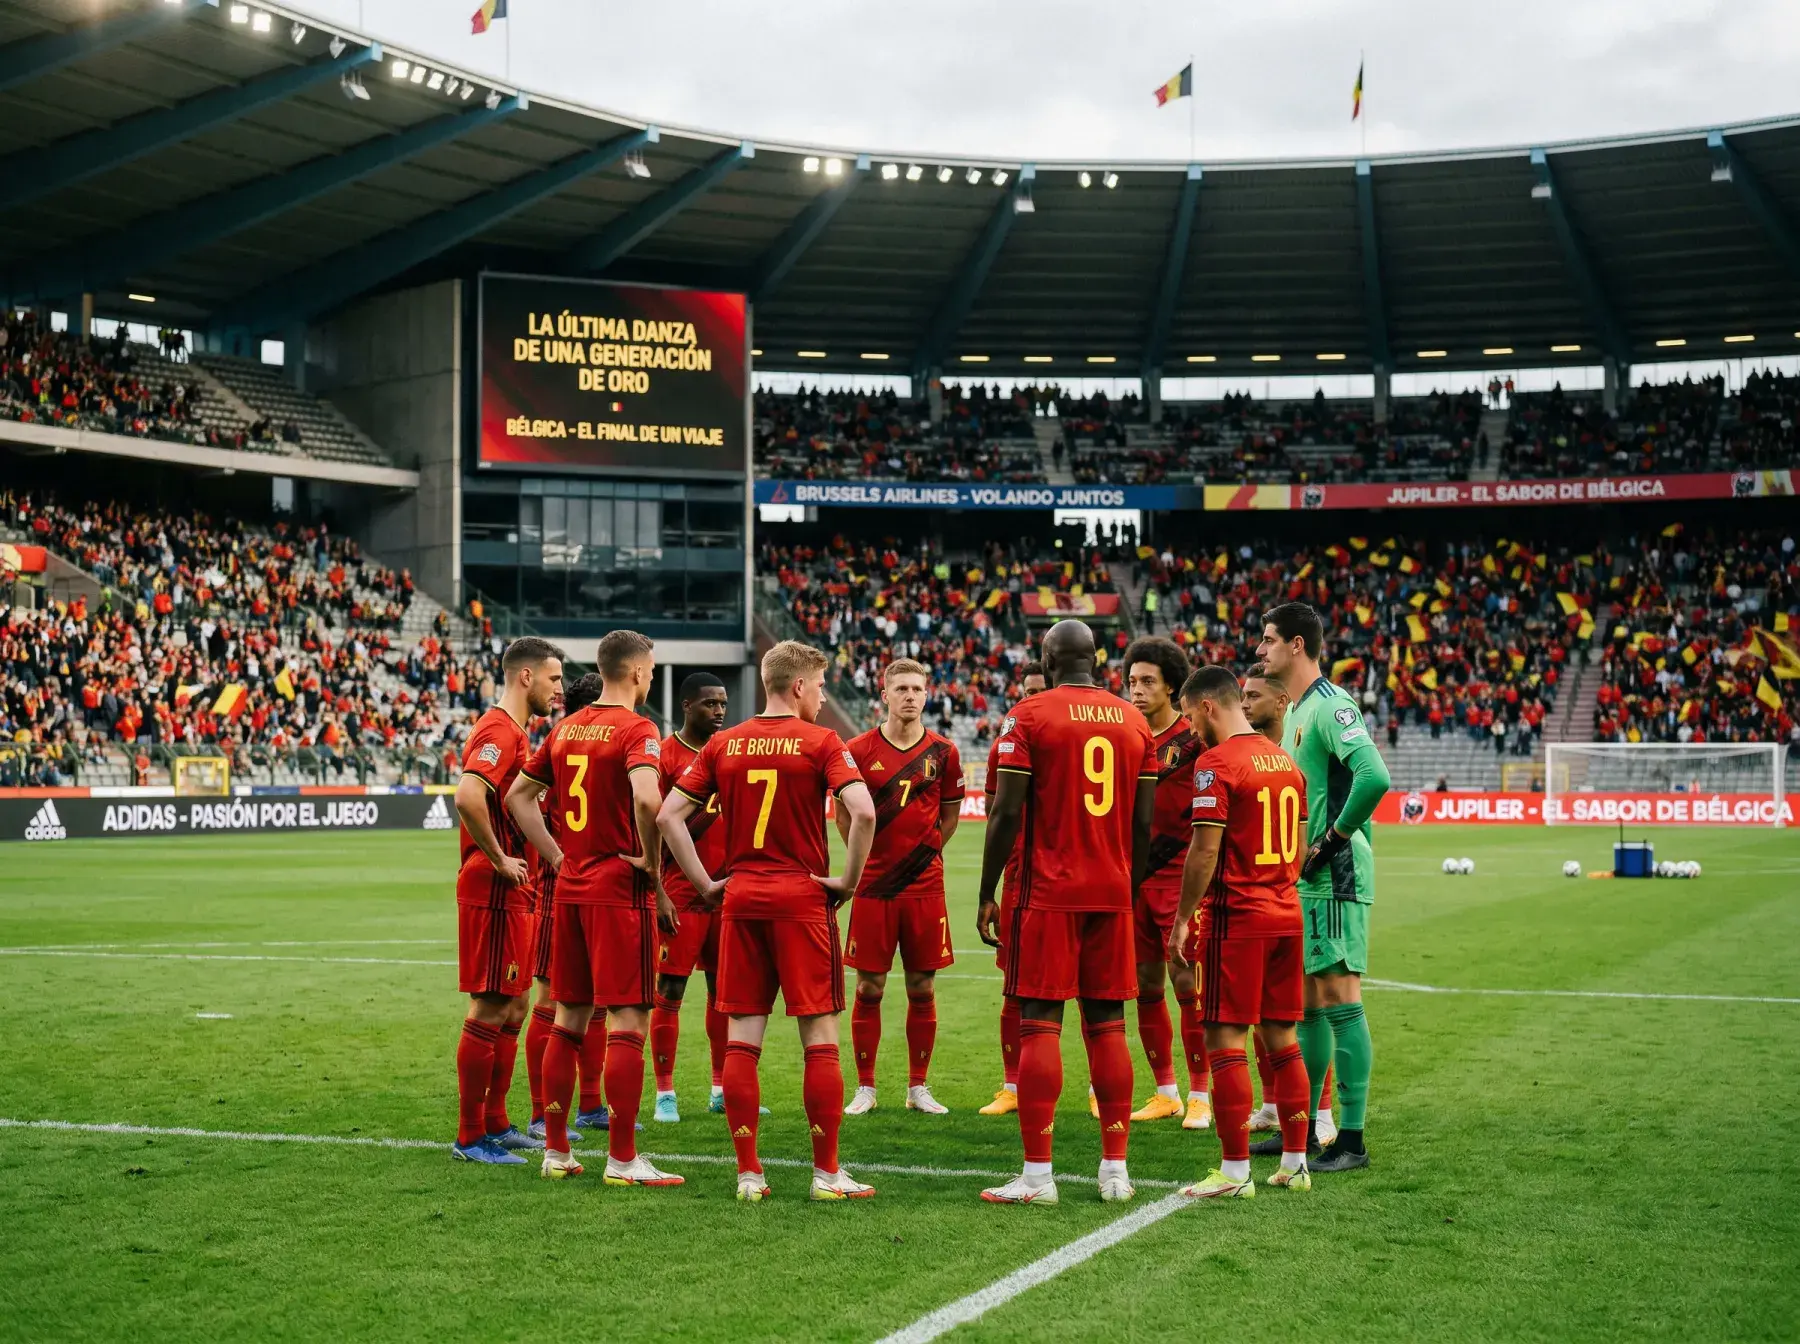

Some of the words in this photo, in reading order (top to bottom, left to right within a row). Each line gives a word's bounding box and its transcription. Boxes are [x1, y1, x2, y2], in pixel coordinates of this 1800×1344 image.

[528, 312, 554, 336] LA
[557, 309, 629, 341] ÚLTIMA
[632, 319, 697, 344] DANZA
[514, 338, 541, 362] DE
[544, 340, 586, 364] UNA
[589, 342, 712, 371] GENERACIÓN
[578, 368, 605, 391] DE
[608, 370, 650, 394] ORO
[506, 415, 567, 438] BÉLGICA
[577, 421, 596, 440] EL
[597, 423, 638, 442] FINAL
[639, 425, 660, 443] DE
[660, 425, 681, 444] UN
[683, 427, 724, 446] VIAJE
[795, 485, 881, 502] BRUSSELS
[883, 487, 958, 504] AIRLINES
[971, 489, 1054, 505] VOLANDO
[1057, 490, 1124, 506] JUNTOS
[1387, 486, 1459, 503] JUPILER
[1471, 485, 1493, 502] EL
[1496, 483, 1556, 501] SABOR
[1560, 482, 1584, 499] DE
[1587, 478, 1665, 499] BÉLGICA
[1069, 704, 1124, 724] LUKAKU
[727, 738, 745, 756] DE
[746, 737, 803, 756] BRUYNE
[1083, 736, 1114, 817] 9
[566, 754, 589, 832] 3
[899, 780, 911, 807] 7
[1434, 799, 1524, 820] JUPILER
[1542, 799, 1570, 820] EL
[1573, 799, 1651, 821] SABOR
[1656, 800, 1689, 821] DE
[1692, 794, 1794, 822] BÉLGICA
[103, 804, 177, 831] ADIDAS
[191, 797, 258, 829] PASIÓN
[260, 802, 297, 827] POR
[299, 802, 320, 826] EL
[322, 801, 379, 826] JUEGO
[747, 769, 777, 849] 7
[1255, 785, 1299, 865] 10
[1309, 908, 1320, 939] 1
